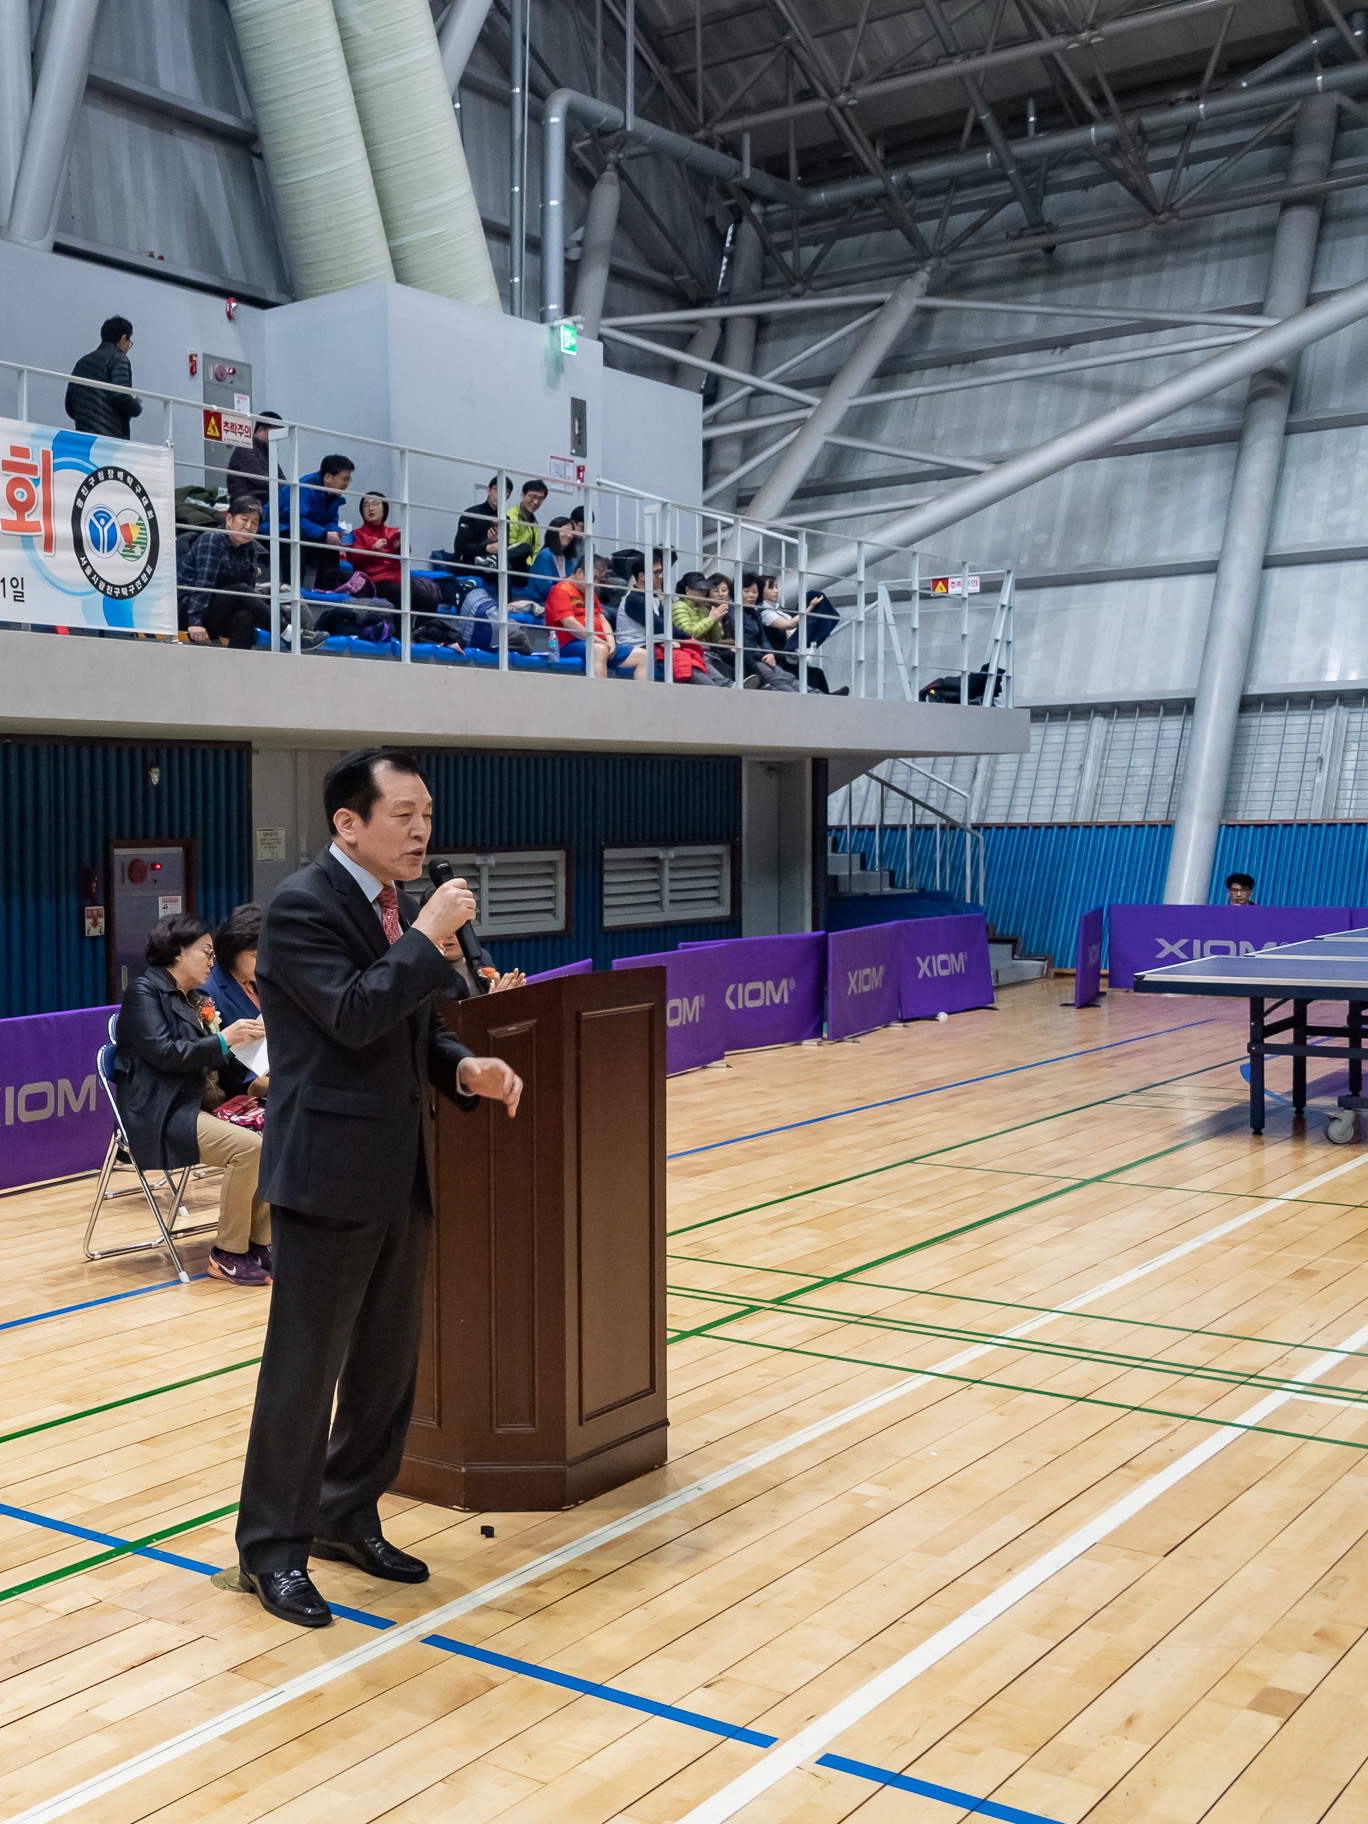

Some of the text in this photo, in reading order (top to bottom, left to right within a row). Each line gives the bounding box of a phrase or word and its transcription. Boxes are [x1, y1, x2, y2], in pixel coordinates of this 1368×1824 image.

[223, 421, 252, 439] 추락주의
[0, 576, 26, 603] 1일
[916, 952, 965, 979] XIOM
[847, 965, 883, 995] XIOM
